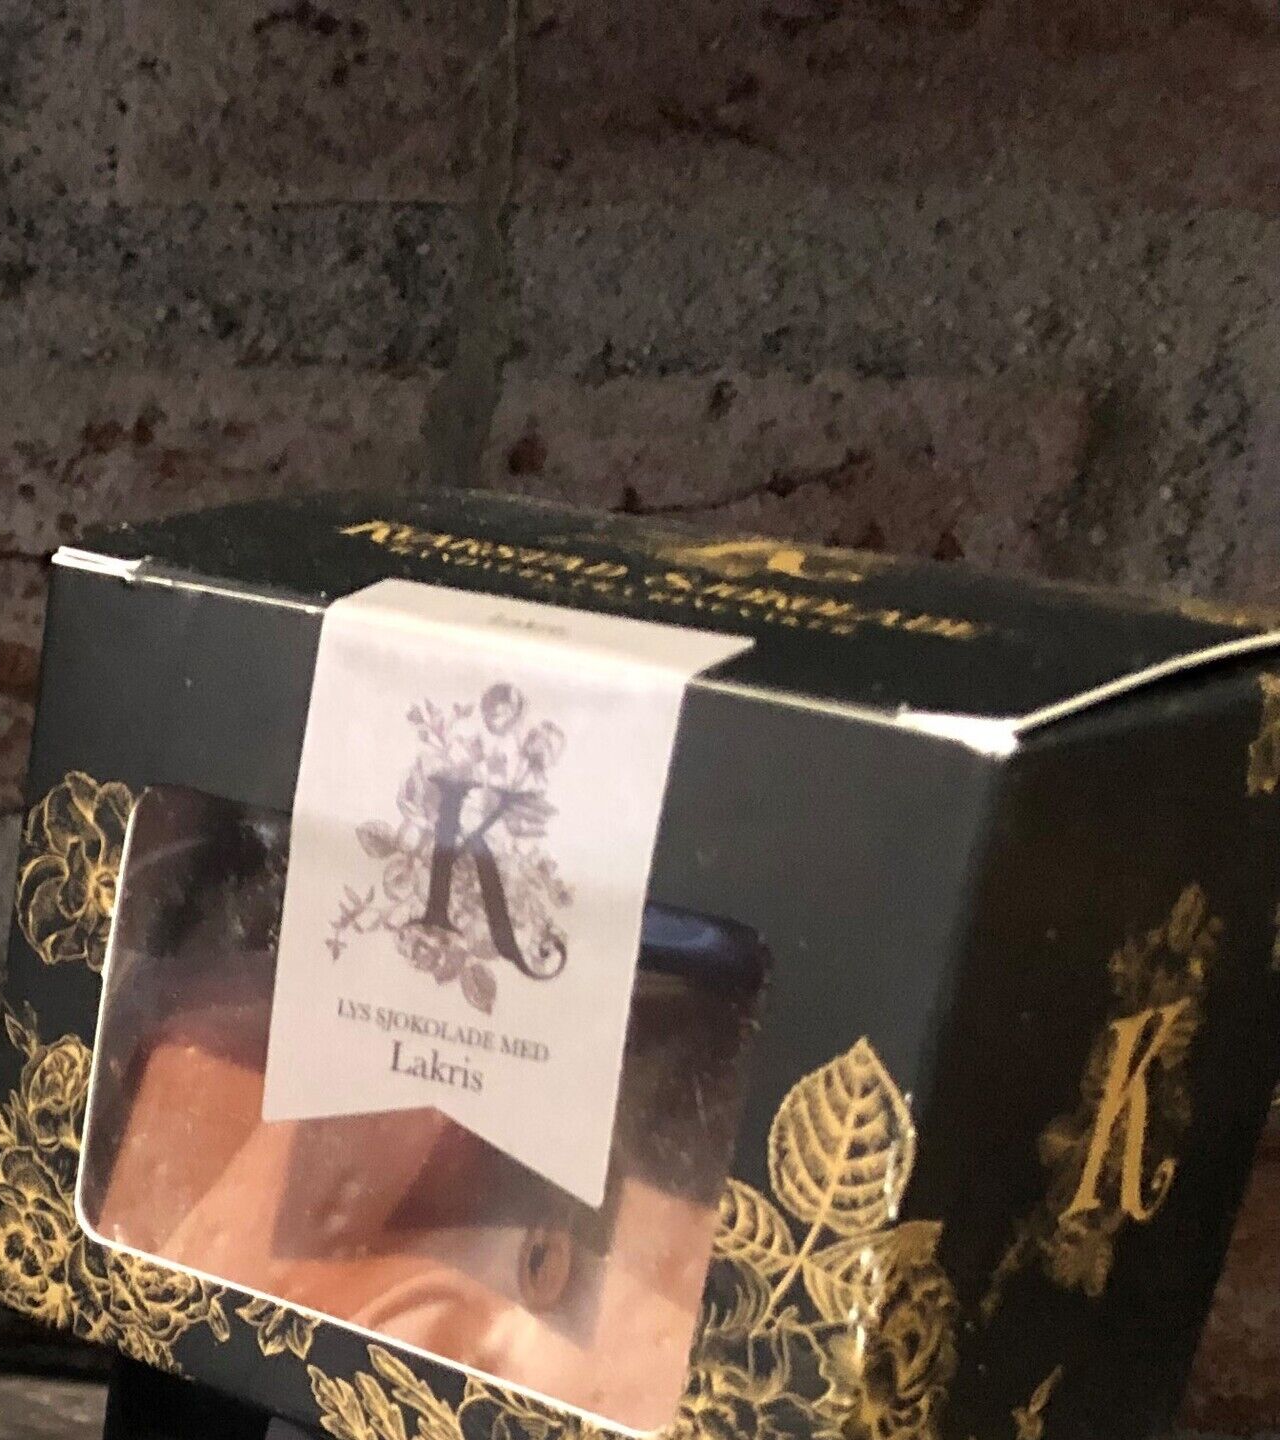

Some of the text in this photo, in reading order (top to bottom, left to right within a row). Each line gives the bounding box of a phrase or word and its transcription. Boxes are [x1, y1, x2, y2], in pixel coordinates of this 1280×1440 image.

[398, 772, 568, 981] K
[337, 997, 550, 1062] LYS SJOKOLADE MED
[391, 1038, 485, 1095] Lakris
[1057, 999, 1192, 1222] K
